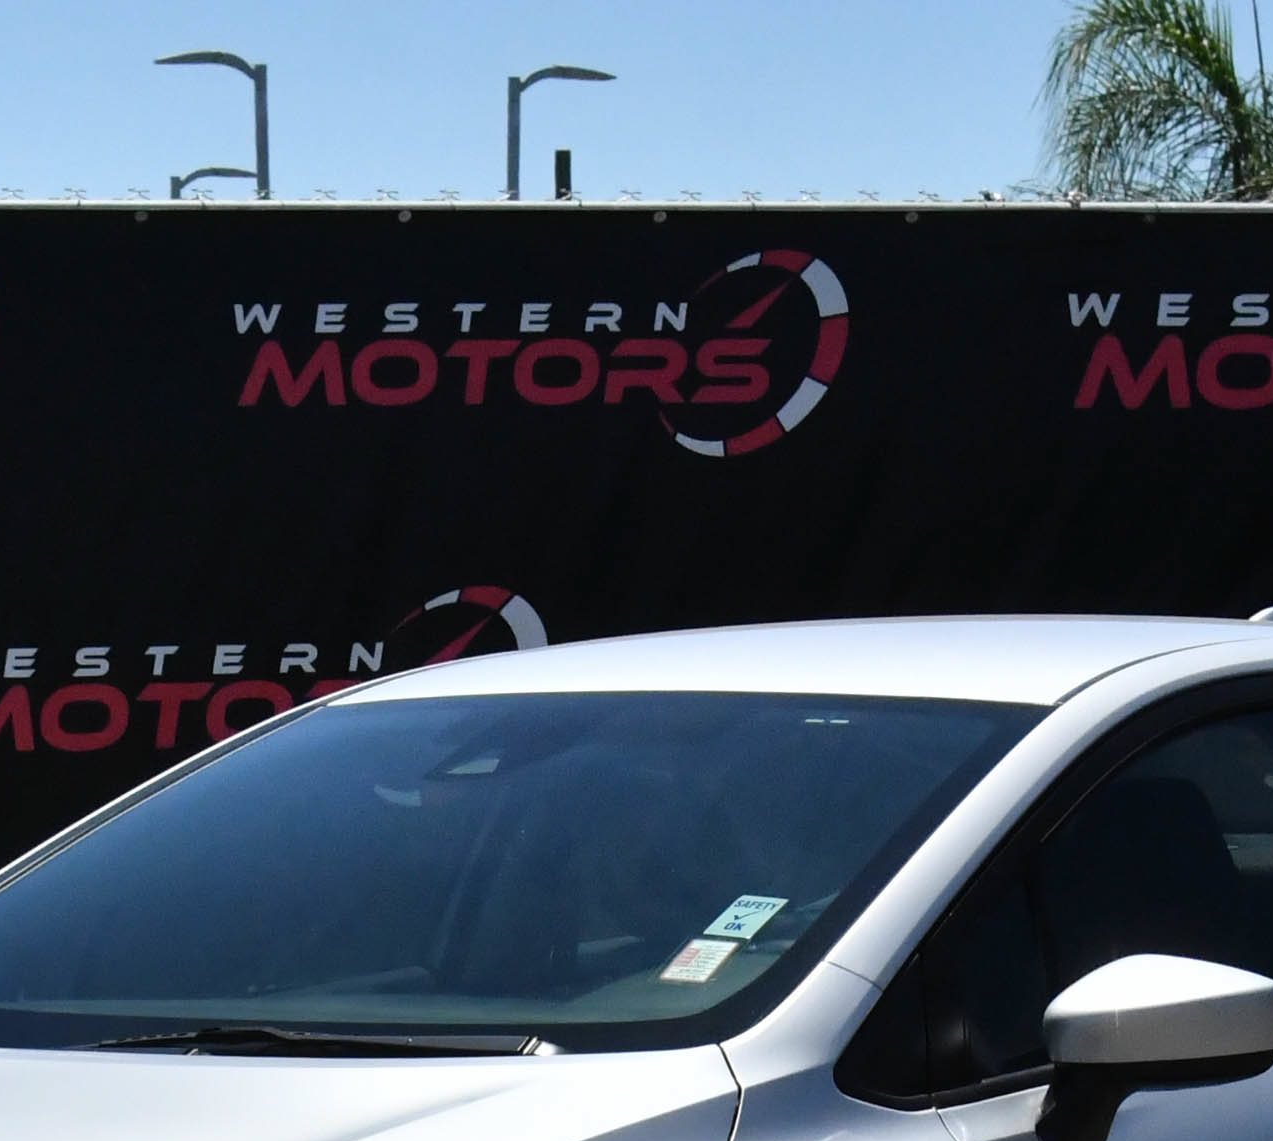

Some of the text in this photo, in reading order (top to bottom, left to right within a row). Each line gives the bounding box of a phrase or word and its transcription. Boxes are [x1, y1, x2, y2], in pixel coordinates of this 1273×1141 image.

[234, 302, 688, 334] WESTERN
[238, 338, 770, 406] MOTORS
[734, 900, 779, 911] SAFETY
[723, 922, 746, 931] OK
